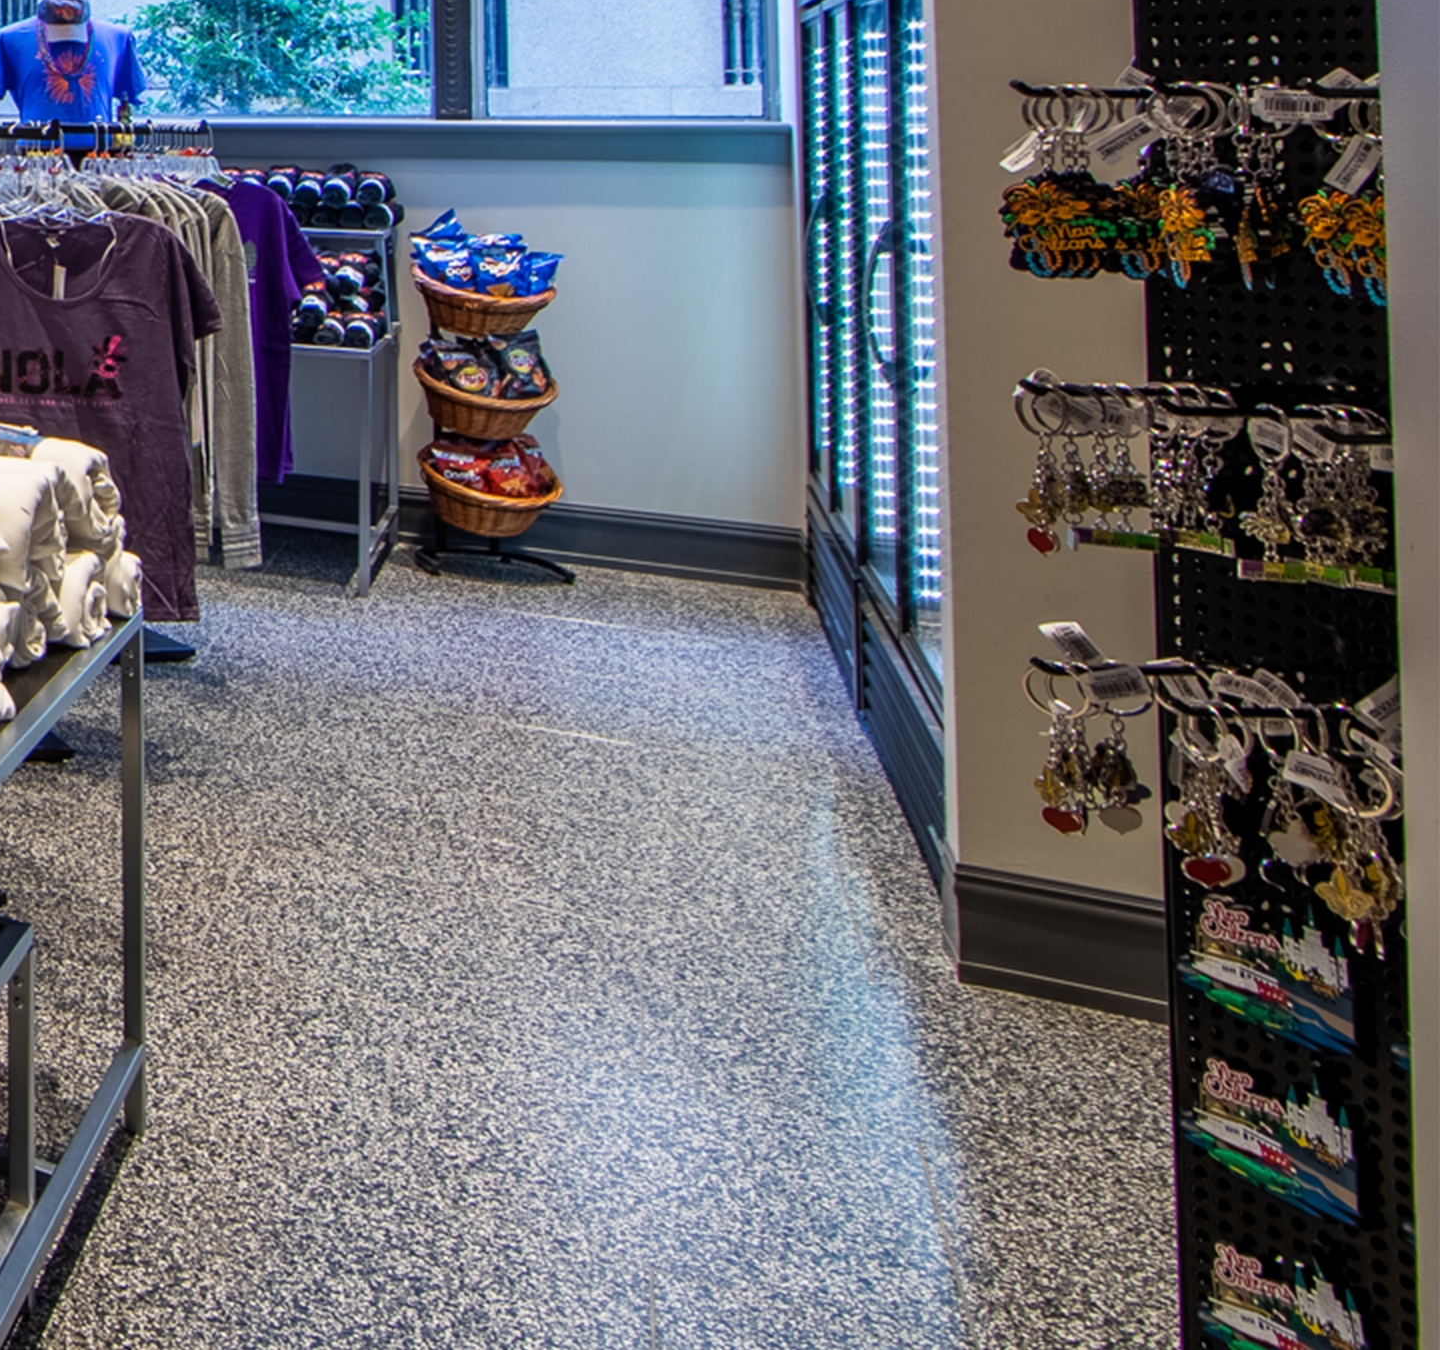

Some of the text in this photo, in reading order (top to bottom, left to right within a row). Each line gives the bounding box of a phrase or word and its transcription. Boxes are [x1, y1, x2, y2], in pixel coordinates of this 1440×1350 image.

[1203, 899, 1250, 927] New
[1200, 914, 1282, 954] Orleans
[1207, 1058, 1254, 1089] New
[1204, 1071, 1285, 1118] Orleans
[1215, 1243, 1263, 1275] New
[1214, 1257, 1297, 1304] Orleans
